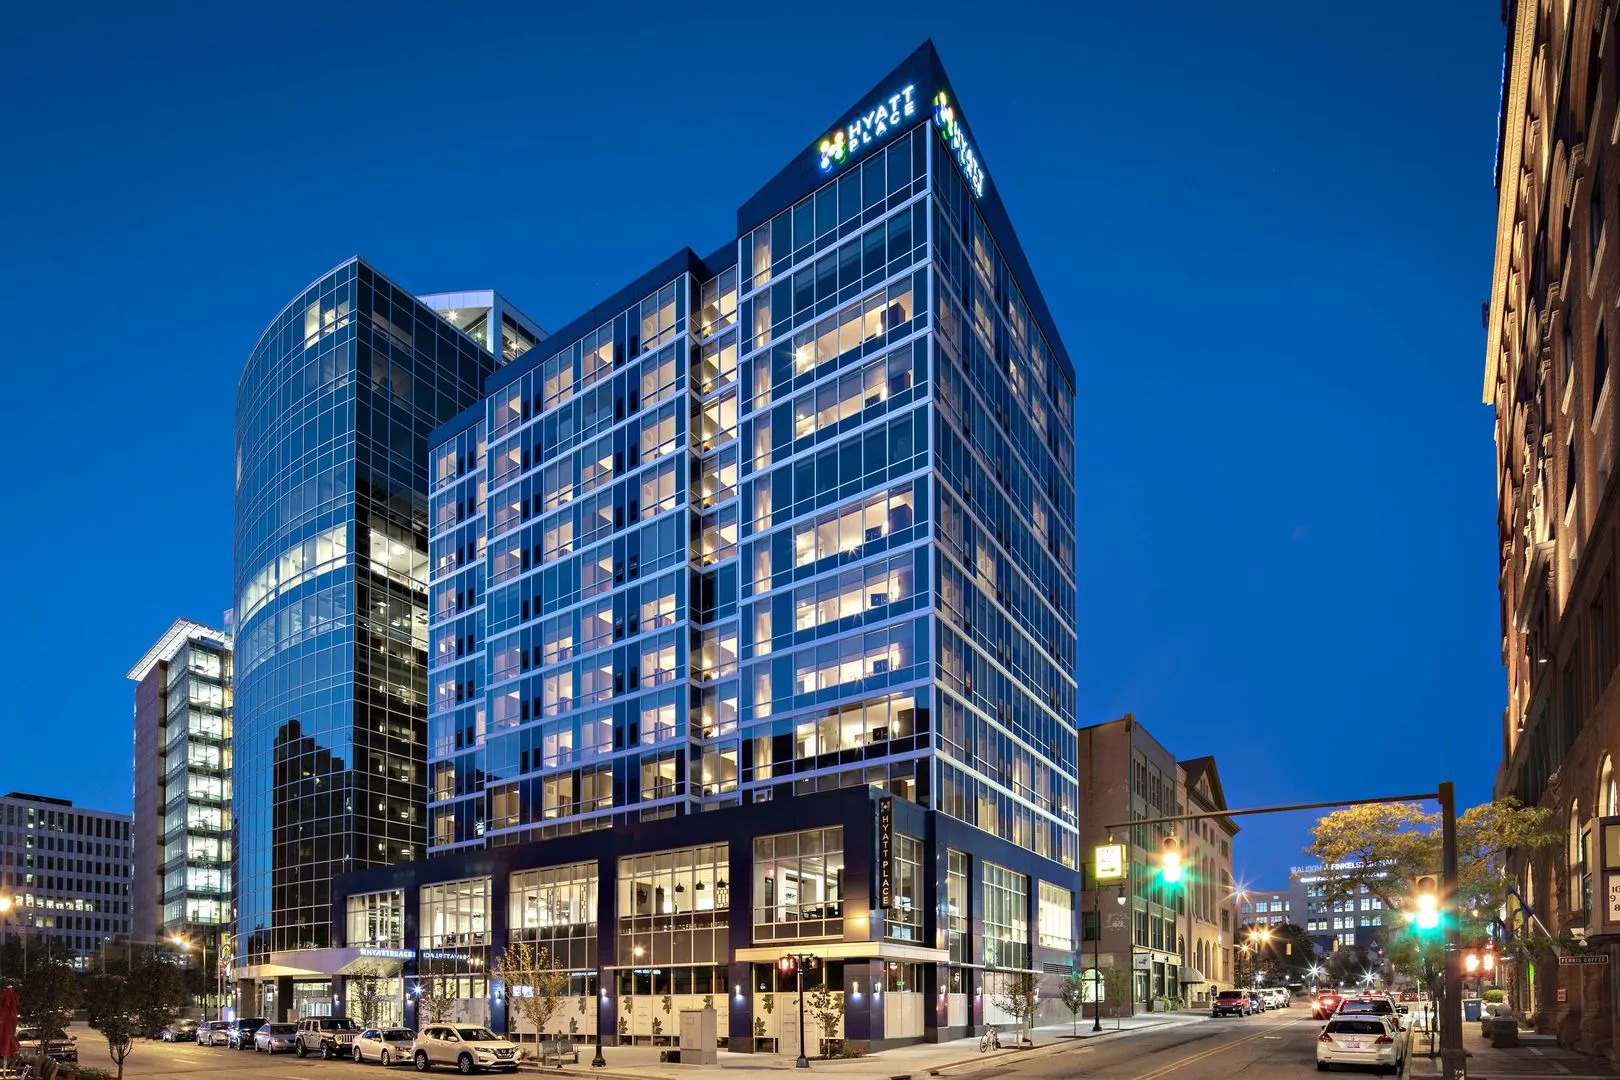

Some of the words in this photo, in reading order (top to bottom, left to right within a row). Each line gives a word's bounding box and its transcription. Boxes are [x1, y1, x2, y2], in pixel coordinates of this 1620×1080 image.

[848, 85, 914, 140] HYATT
[849, 101, 915, 152] PLACE
[1330, 861, 1377, 871] FINKELST
